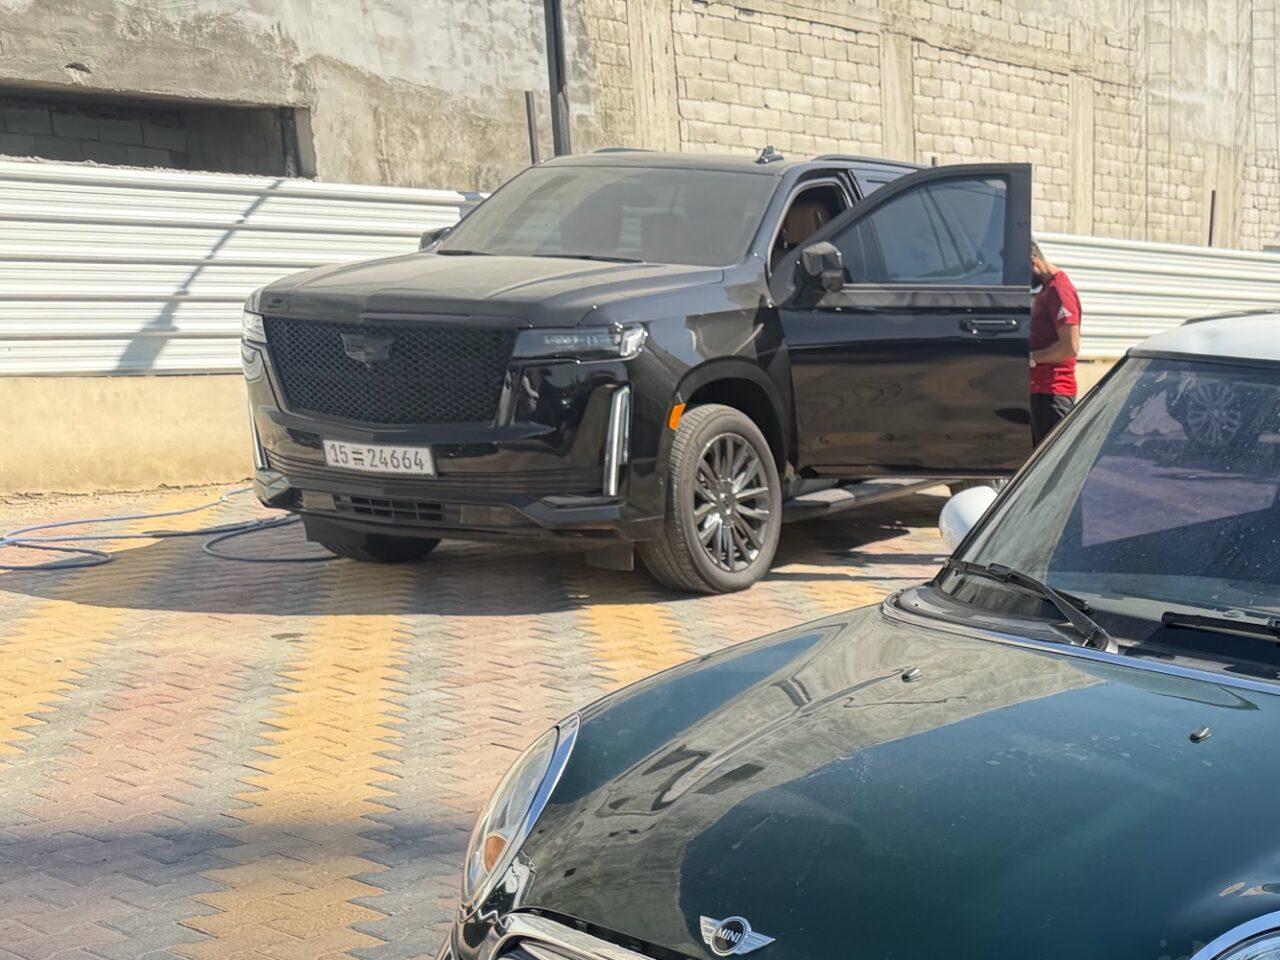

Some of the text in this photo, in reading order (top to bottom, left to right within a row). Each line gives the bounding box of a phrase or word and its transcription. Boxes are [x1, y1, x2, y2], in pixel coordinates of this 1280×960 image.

[330, 443, 424, 471] 15 24664
[715, 927, 742, 944] MINI
